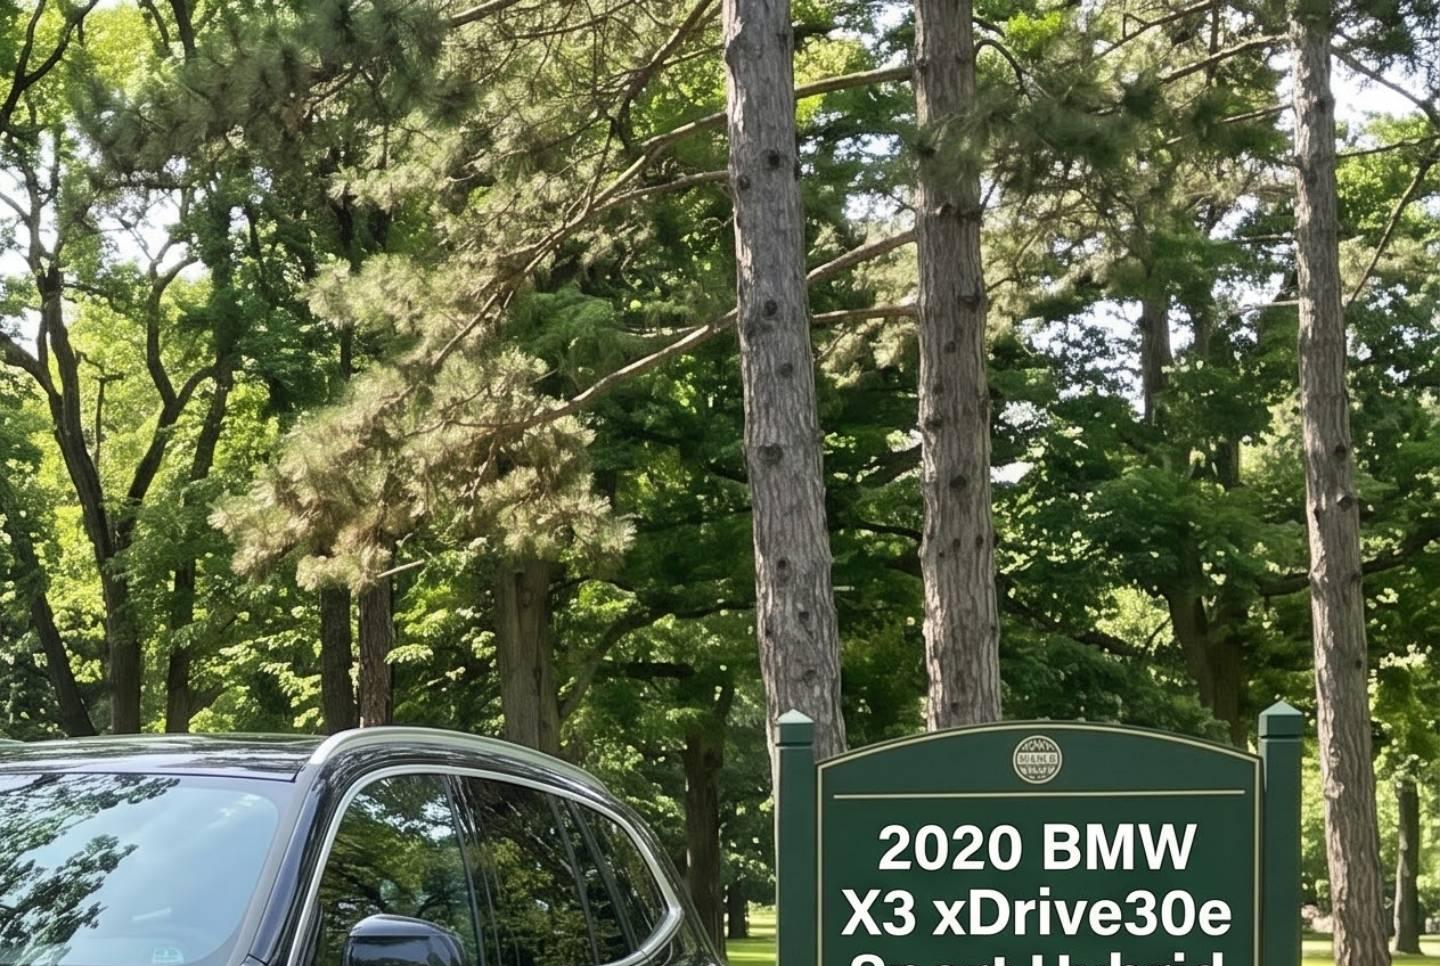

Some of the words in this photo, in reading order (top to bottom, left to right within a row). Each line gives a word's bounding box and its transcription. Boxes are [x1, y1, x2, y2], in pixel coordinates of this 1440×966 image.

[878, 824, 1023, 871] 2020
[1043, 823, 1198, 870] BMW
[841, 889, 916, 936] X3
[932, 886, 1232, 936] xDrive30e
